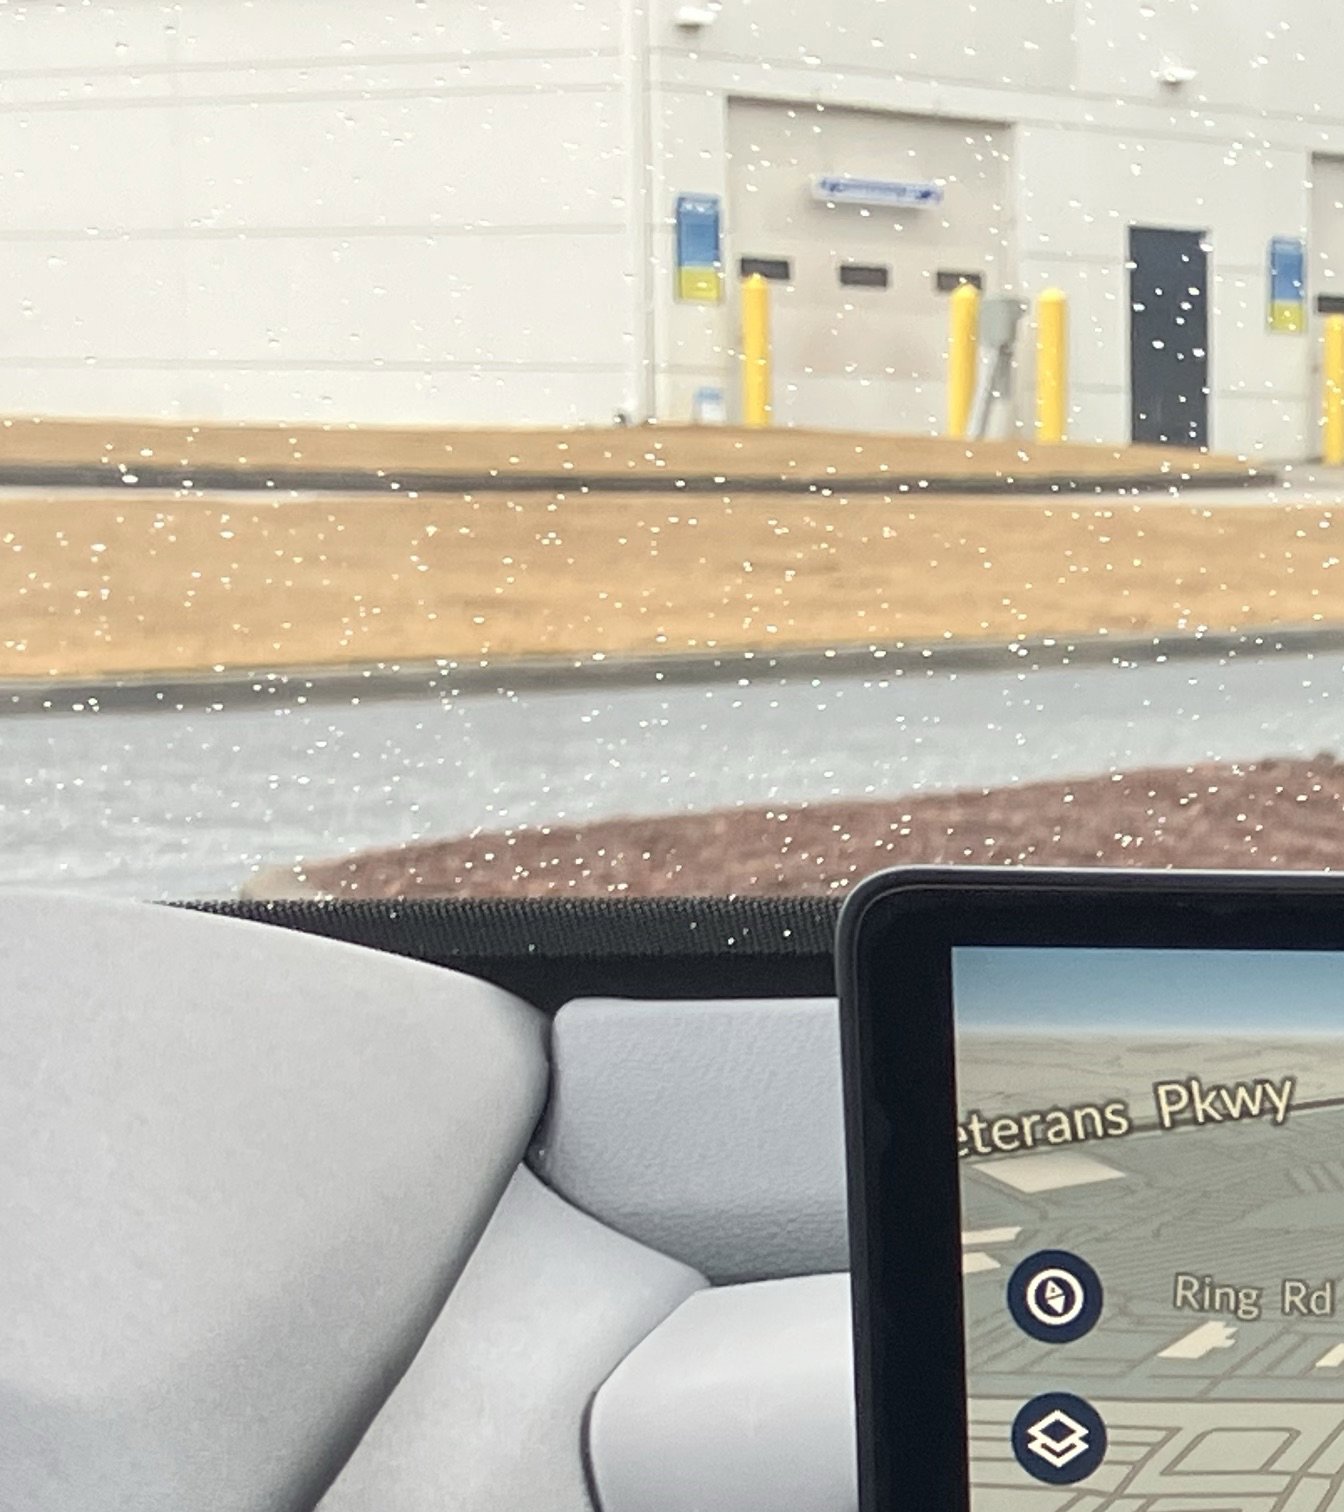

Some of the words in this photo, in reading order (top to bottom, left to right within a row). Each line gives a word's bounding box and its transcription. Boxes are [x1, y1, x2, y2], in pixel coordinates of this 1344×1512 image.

[1157, 1079, 1292, 1128] Pkwy
[1173, 1275, 1261, 1320] Ring
[1283, 1280, 1332, 1315] Rd
